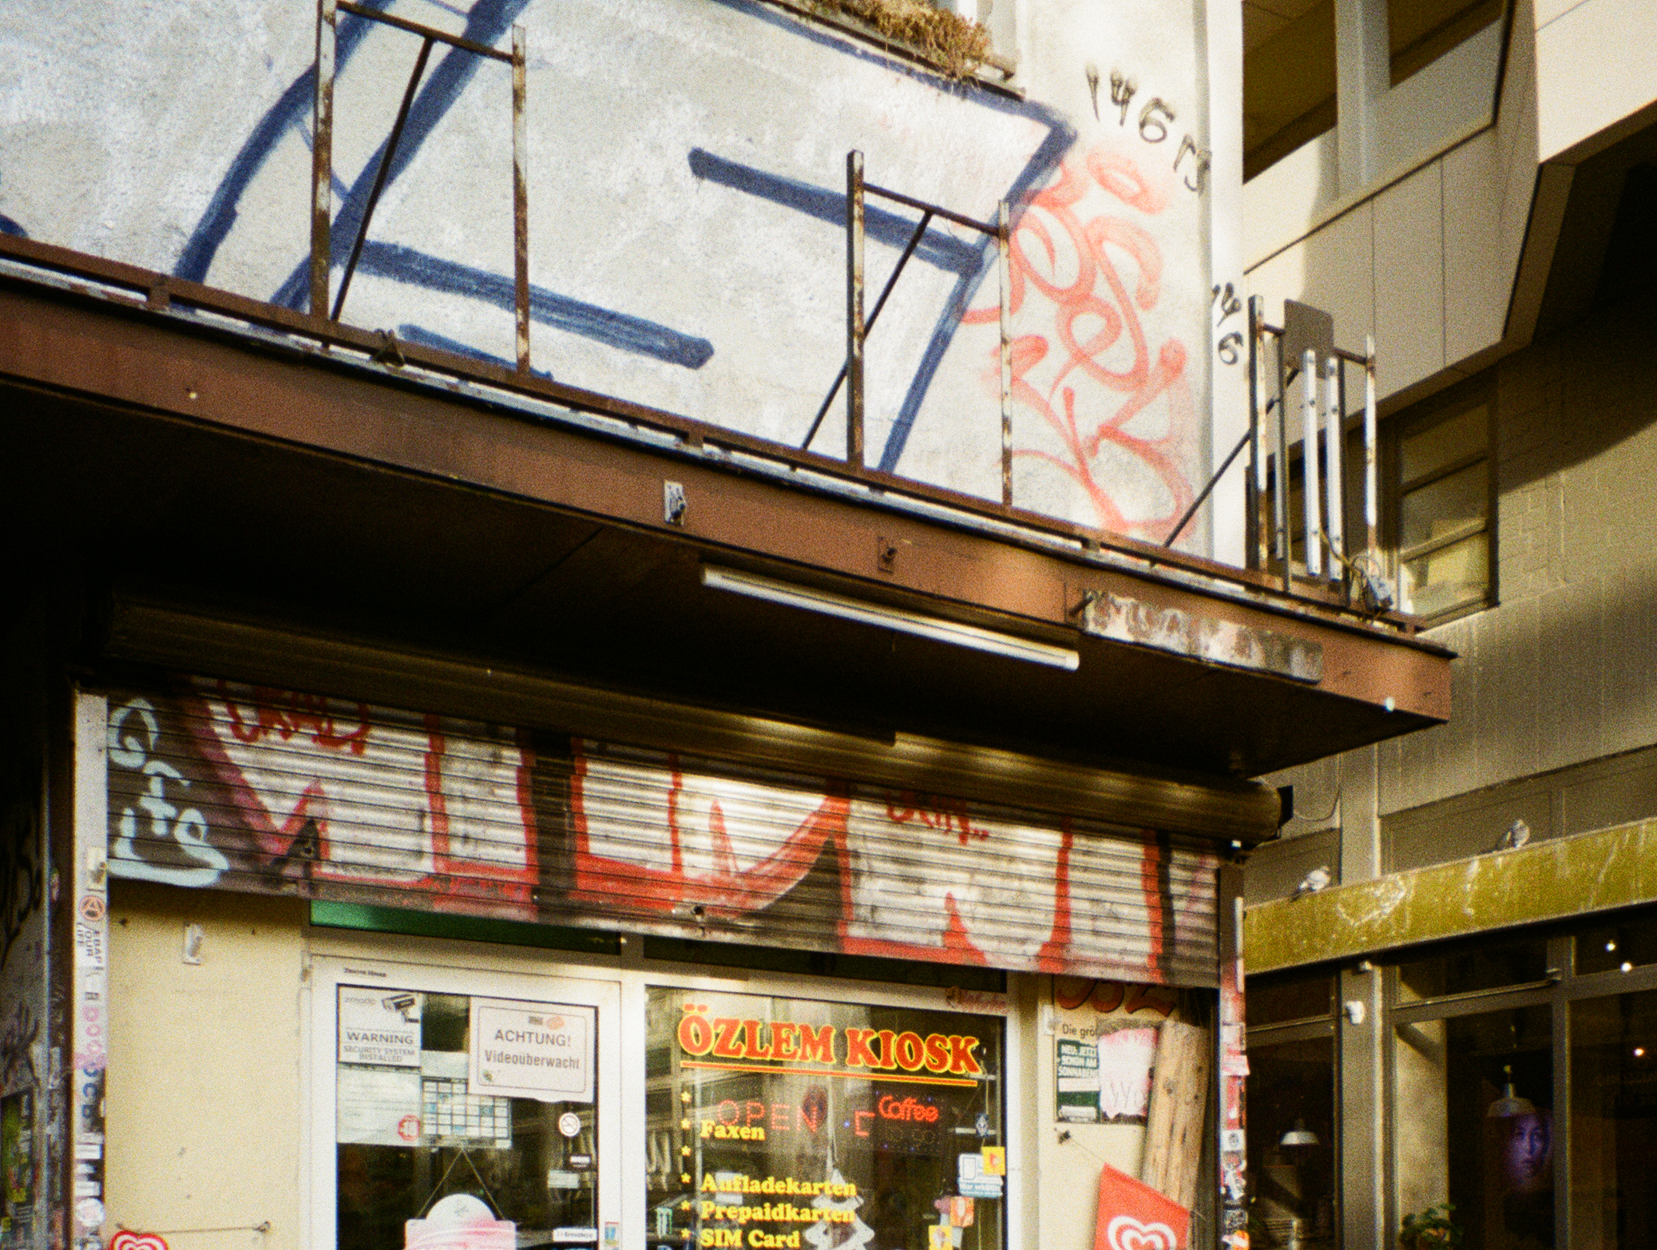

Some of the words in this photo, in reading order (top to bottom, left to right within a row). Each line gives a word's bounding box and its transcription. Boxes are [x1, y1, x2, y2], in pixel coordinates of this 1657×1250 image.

[346, 1031, 413, 1045] WARNING
[494, 1028, 572, 1047] ACHTUNG!
[677, 1003, 837, 1065] ÖZLEM
[845, 1027, 983, 1075] KIOSK
[1062, 1023, 1077, 1036] Die
[343, 1045, 382, 1055] SECURITY
[384, 1047, 415, 1056] SYSTEM
[359, 1053, 402, 1062] INSTALLED
[718, 1099, 818, 1133] OPEN
[878, 1094, 939, 1123] Coffee
[700, 1119, 766, 1142] Faxen
[701, 1172, 857, 1198] Aufladekarten
[701, 1201, 857, 1225] Prepaidkarten
[701, 1229, 743, 1249] SIM
[748, 1229, 801, 1249] Card
